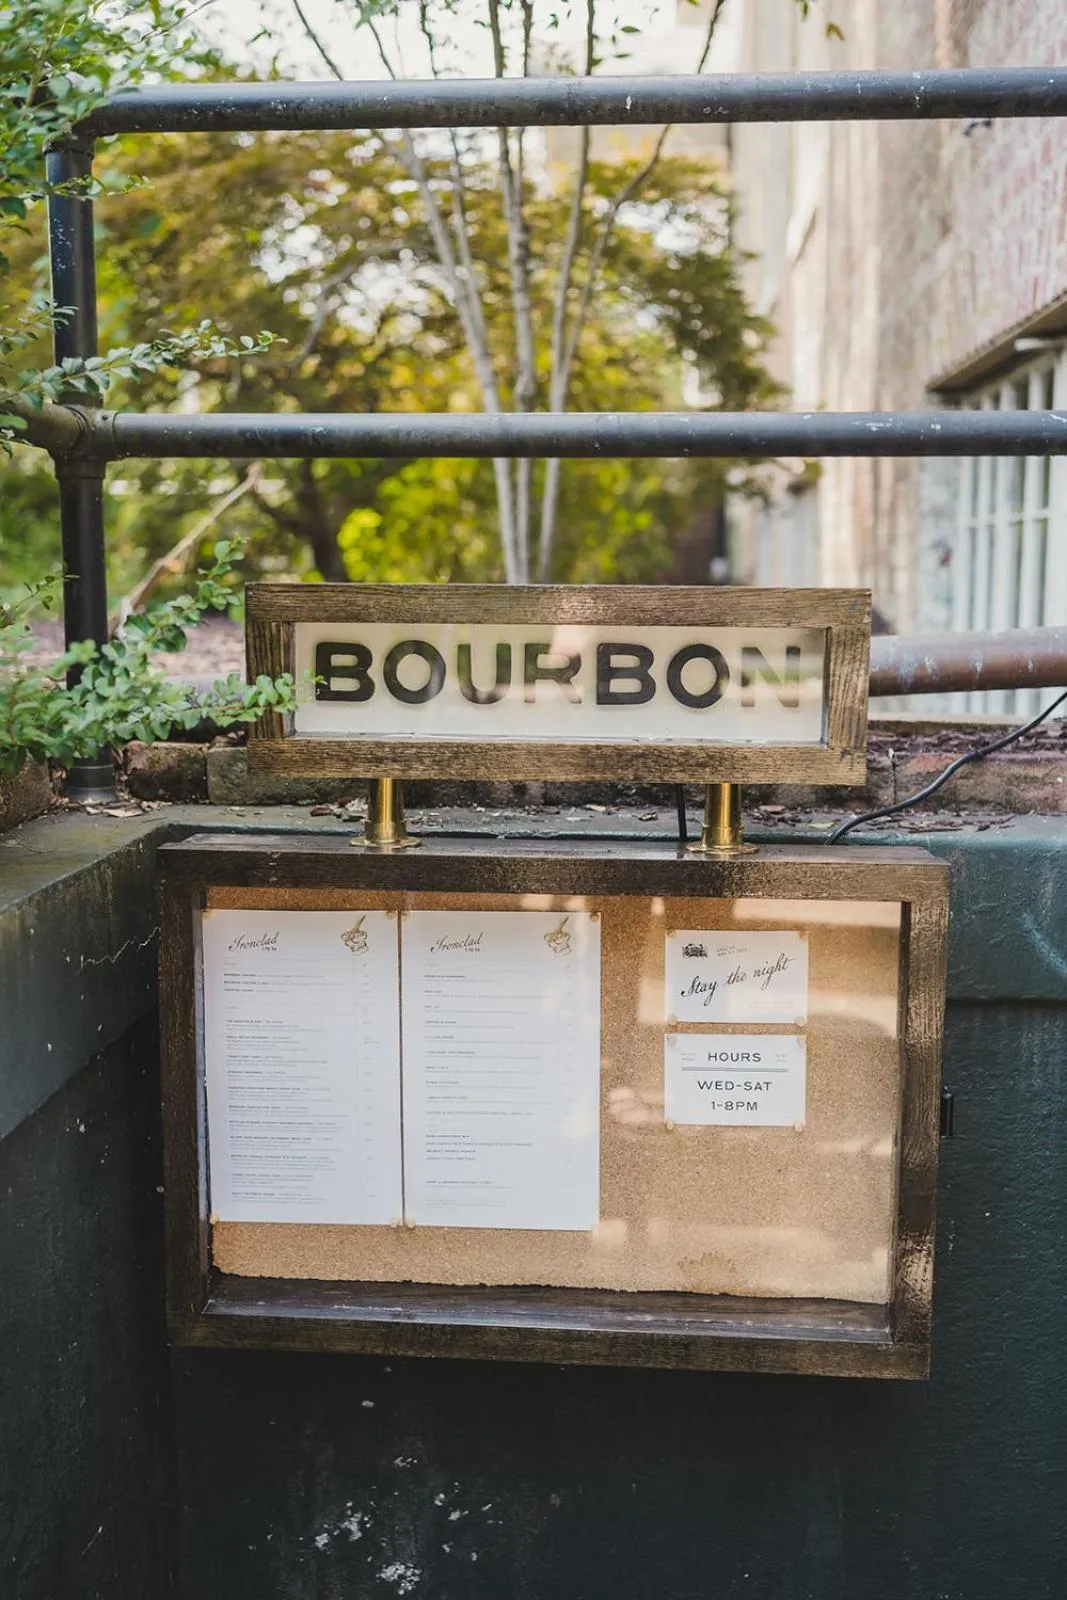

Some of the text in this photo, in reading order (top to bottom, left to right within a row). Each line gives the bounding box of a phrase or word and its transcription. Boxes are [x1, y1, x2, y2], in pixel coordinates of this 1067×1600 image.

[314, 639, 801, 709] BOURBON
[228, 931, 280, 952] Ironclad
[430, 931, 484, 953] Ironclad
[680, 952, 795, 1007] Stay the night
[707, 1052, 762, 1063] HOURS
[697, 1080, 773, 1091] WED-SAT
[711, 1101, 758, 1111] 1-8PM
